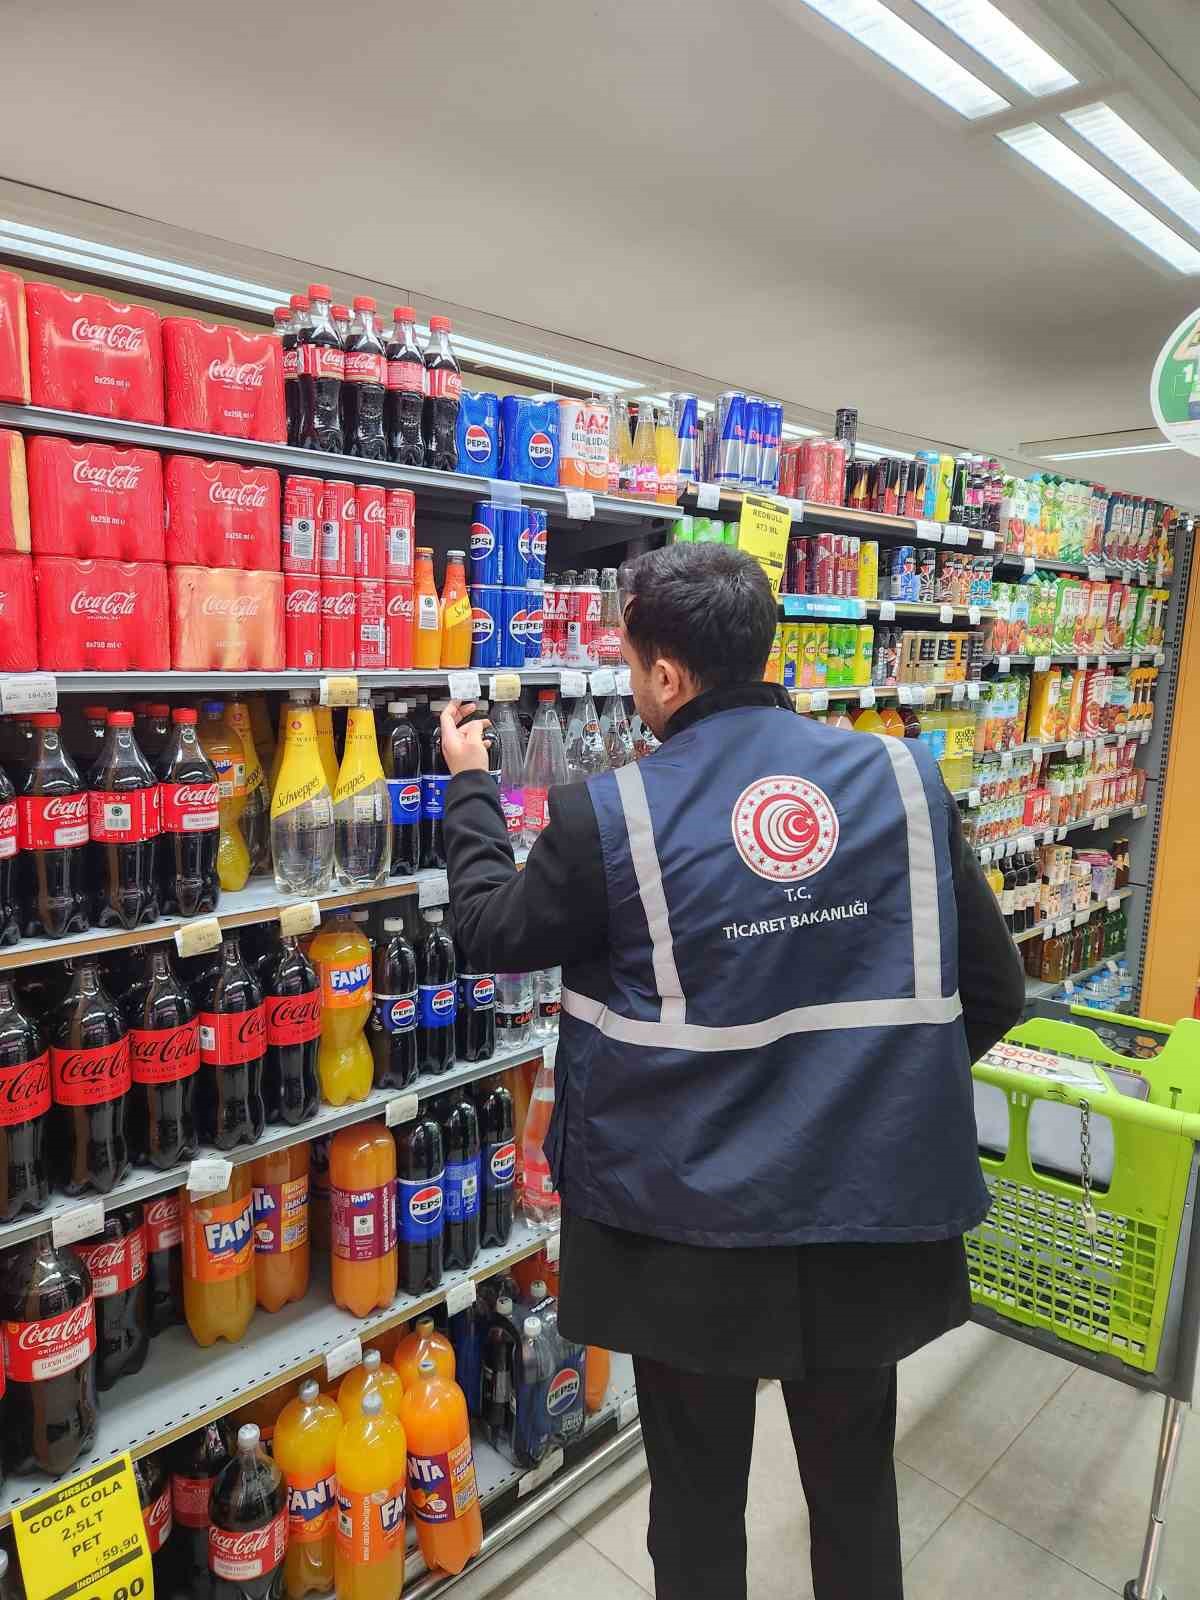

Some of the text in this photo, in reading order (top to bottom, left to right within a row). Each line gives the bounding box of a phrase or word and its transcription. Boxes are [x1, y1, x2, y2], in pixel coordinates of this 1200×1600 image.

[73, 460, 144, 489] Coca-Cola
[209, 482, 269, 507] Coca-Cola
[70, 590, 138, 615] Coca-Cola
[276, 775, 320, 809] Schweppes
[783, 886, 812, 902] T.C.
[722, 900, 869, 940] TİCARET BAKANLIĞI
[29, 1480, 122, 1535] COCA COLA
[62, 1510, 104, 1542] 2,5LT
[72, 1532, 102, 1558] PET
